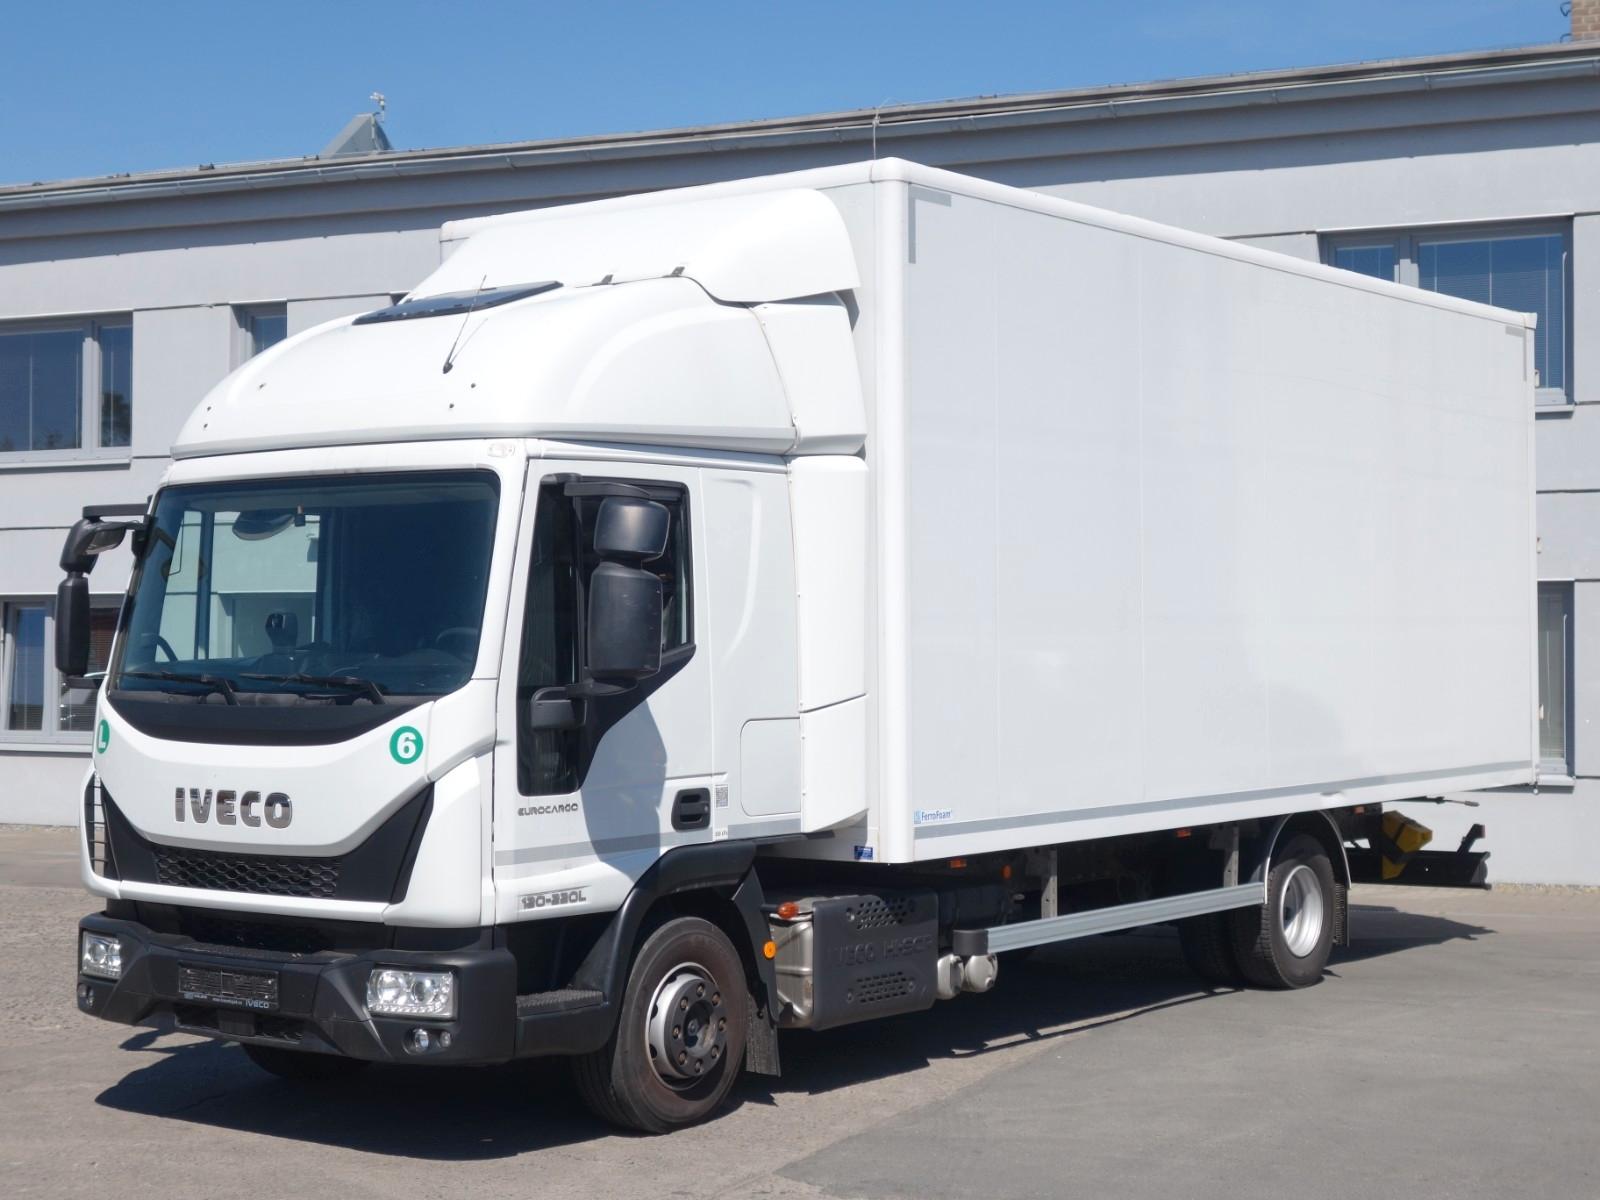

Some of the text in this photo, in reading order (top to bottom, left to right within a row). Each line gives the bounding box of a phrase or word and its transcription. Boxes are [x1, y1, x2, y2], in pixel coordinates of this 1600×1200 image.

[396, 732, 416, 759] 6
[175, 787, 293, 829] IVECO
[518, 803, 579, 816] EUROCARGO
[245, 999, 270, 1009] IVECO
